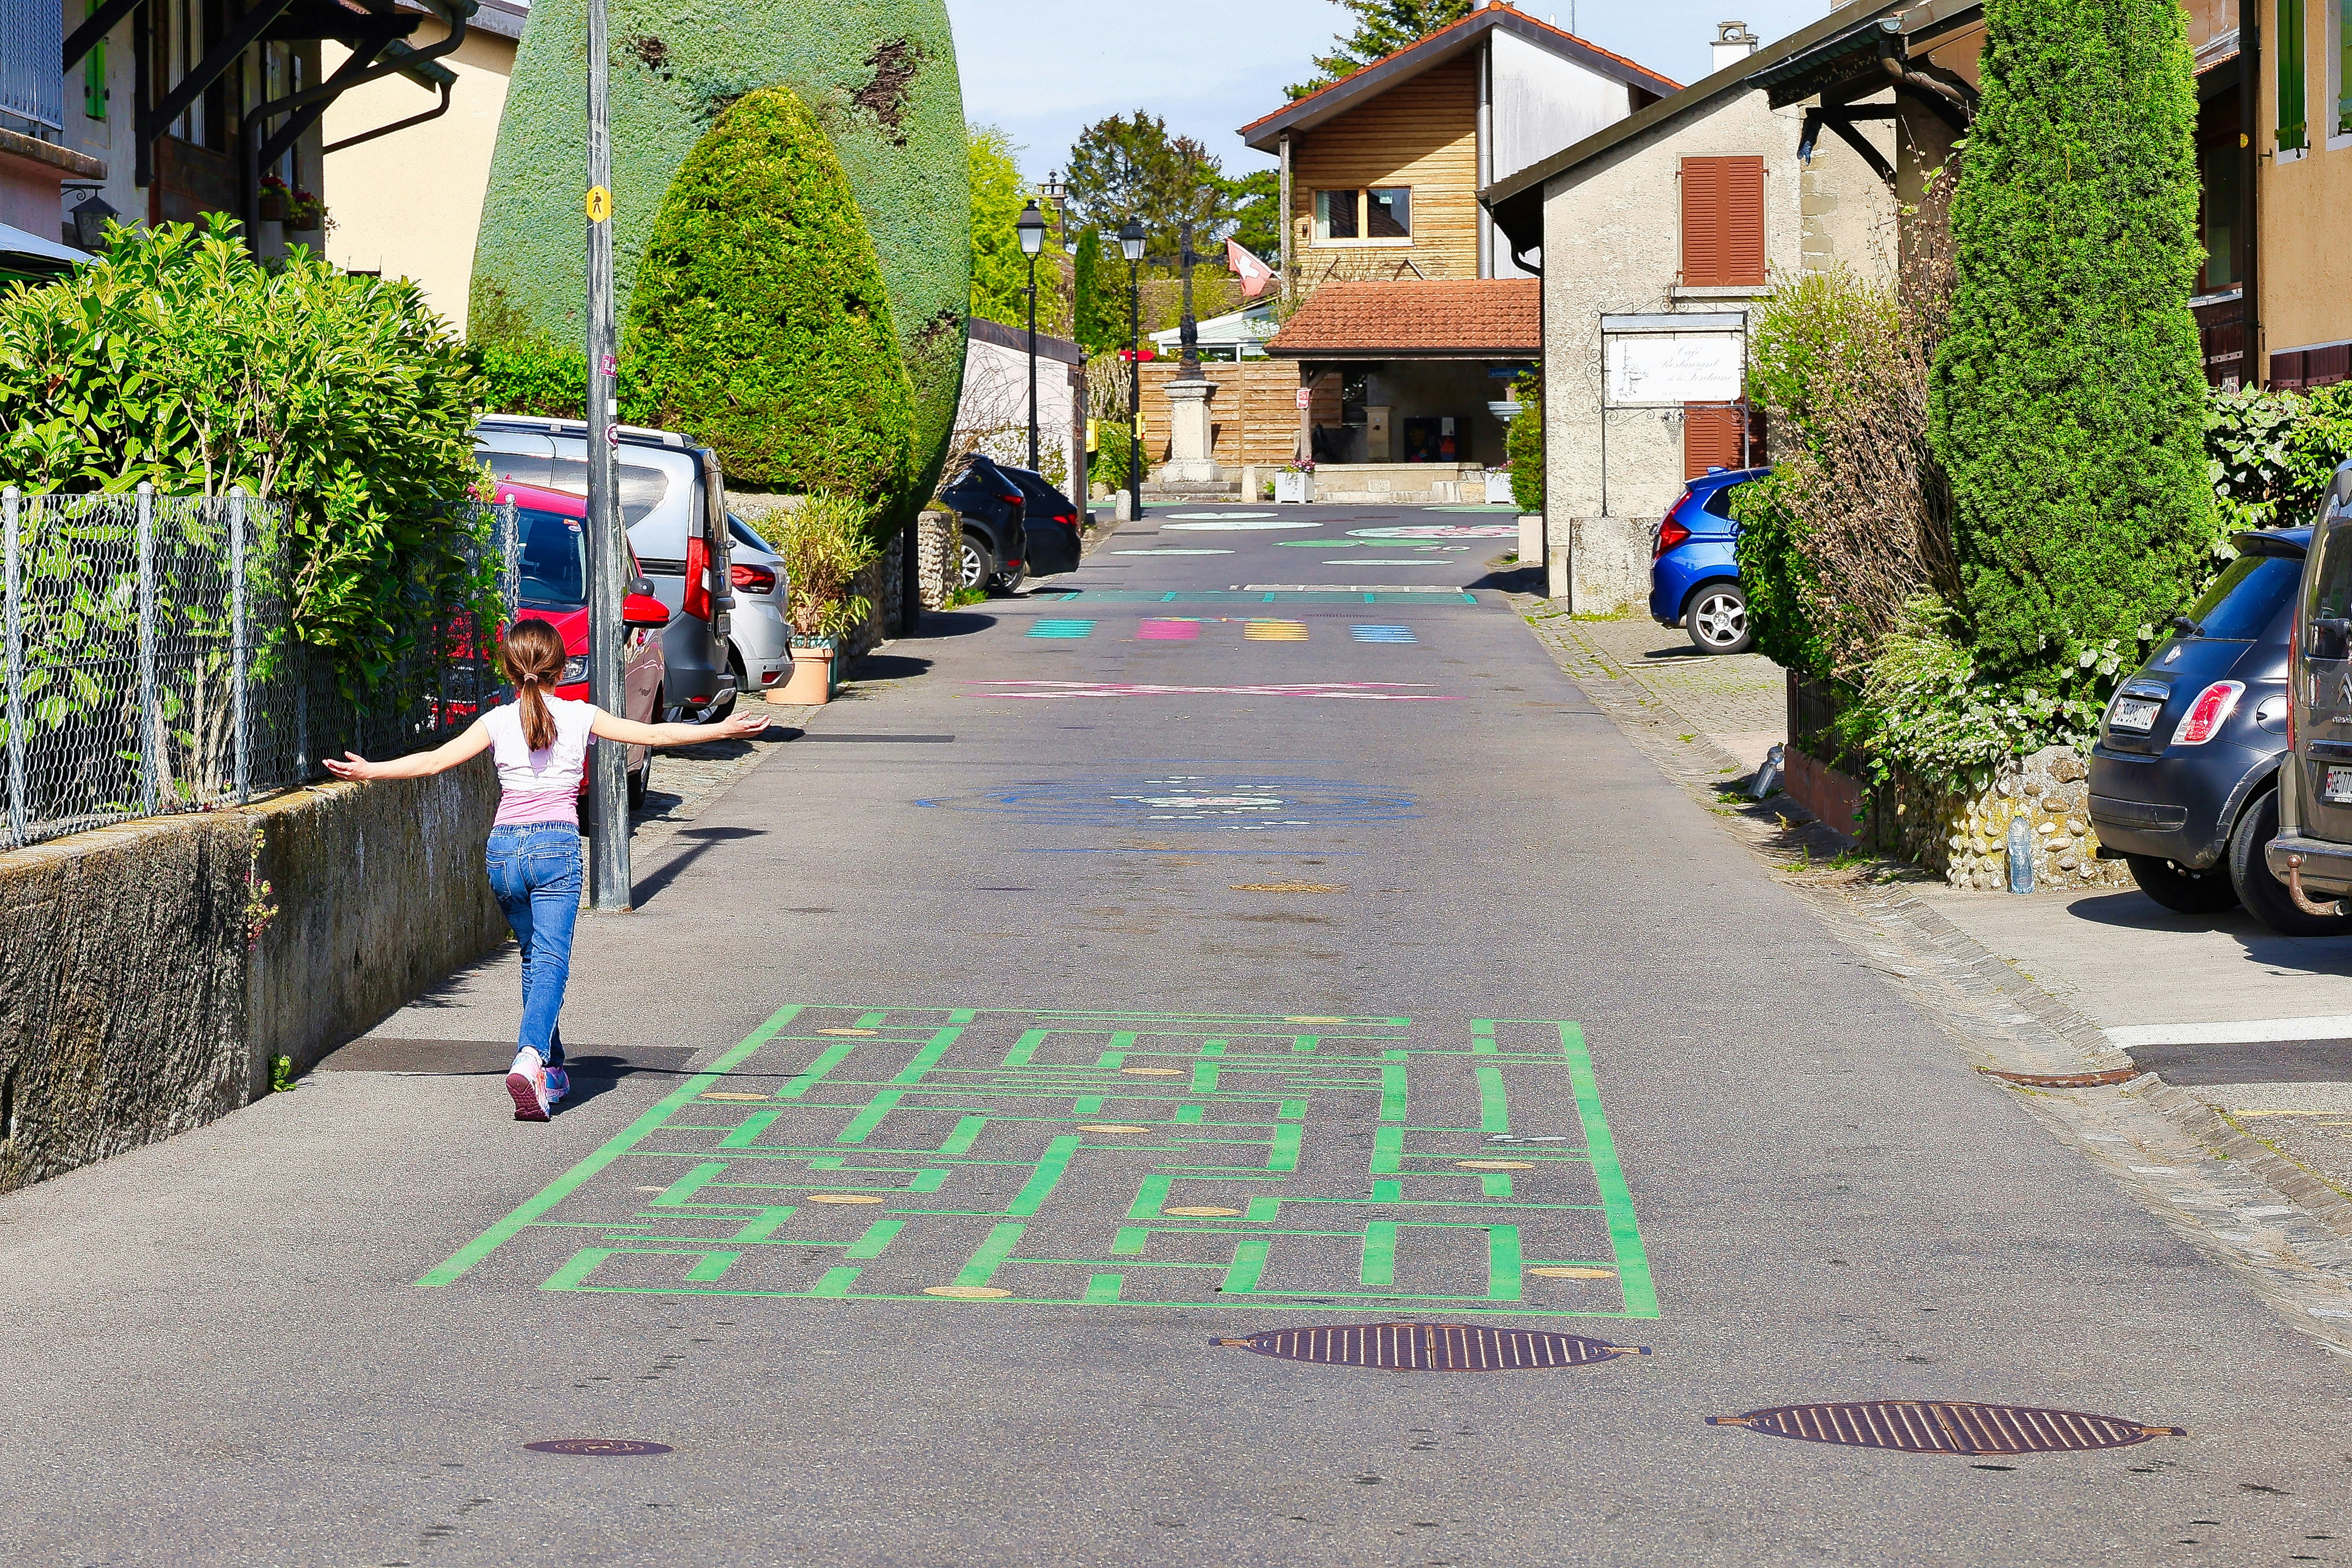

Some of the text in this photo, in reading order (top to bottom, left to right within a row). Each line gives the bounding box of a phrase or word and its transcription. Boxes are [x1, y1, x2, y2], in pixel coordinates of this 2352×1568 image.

[1677, 343, 1703, 361] Café
[1656, 356, 1720, 369] Restaurant
[1685, 368, 1733, 382] Fontaine
